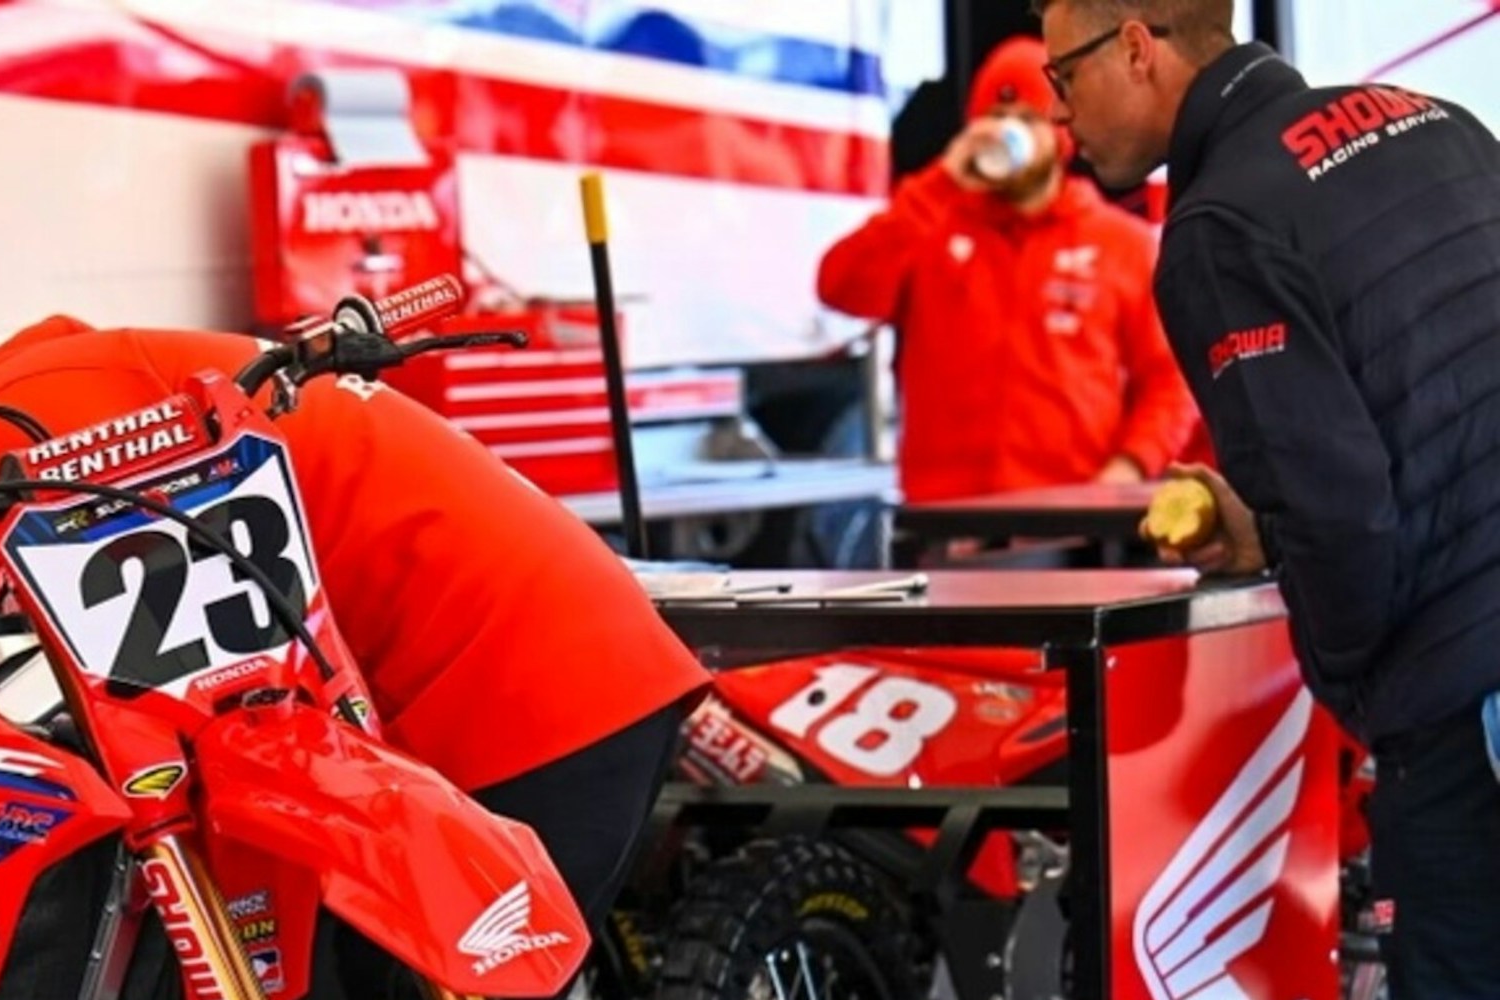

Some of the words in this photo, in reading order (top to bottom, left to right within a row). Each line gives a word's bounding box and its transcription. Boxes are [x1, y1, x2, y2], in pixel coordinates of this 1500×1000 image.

[1281, 86, 1436, 170] SHOWA
[1307, 132, 1380, 181] RACING
[1385, 107, 1449, 137] SERVICE
[304, 190, 439, 233] HONDA
[381, 287, 455, 326] RENTHAL
[28, 400, 183, 464] RENTHAL
[39, 423, 194, 482] RENTHAL
[79, 493, 309, 701] 23
[194, 657, 269, 690] HONDA
[768, 663, 957, 778] 18
[470, 931, 572, 978] HONDA
